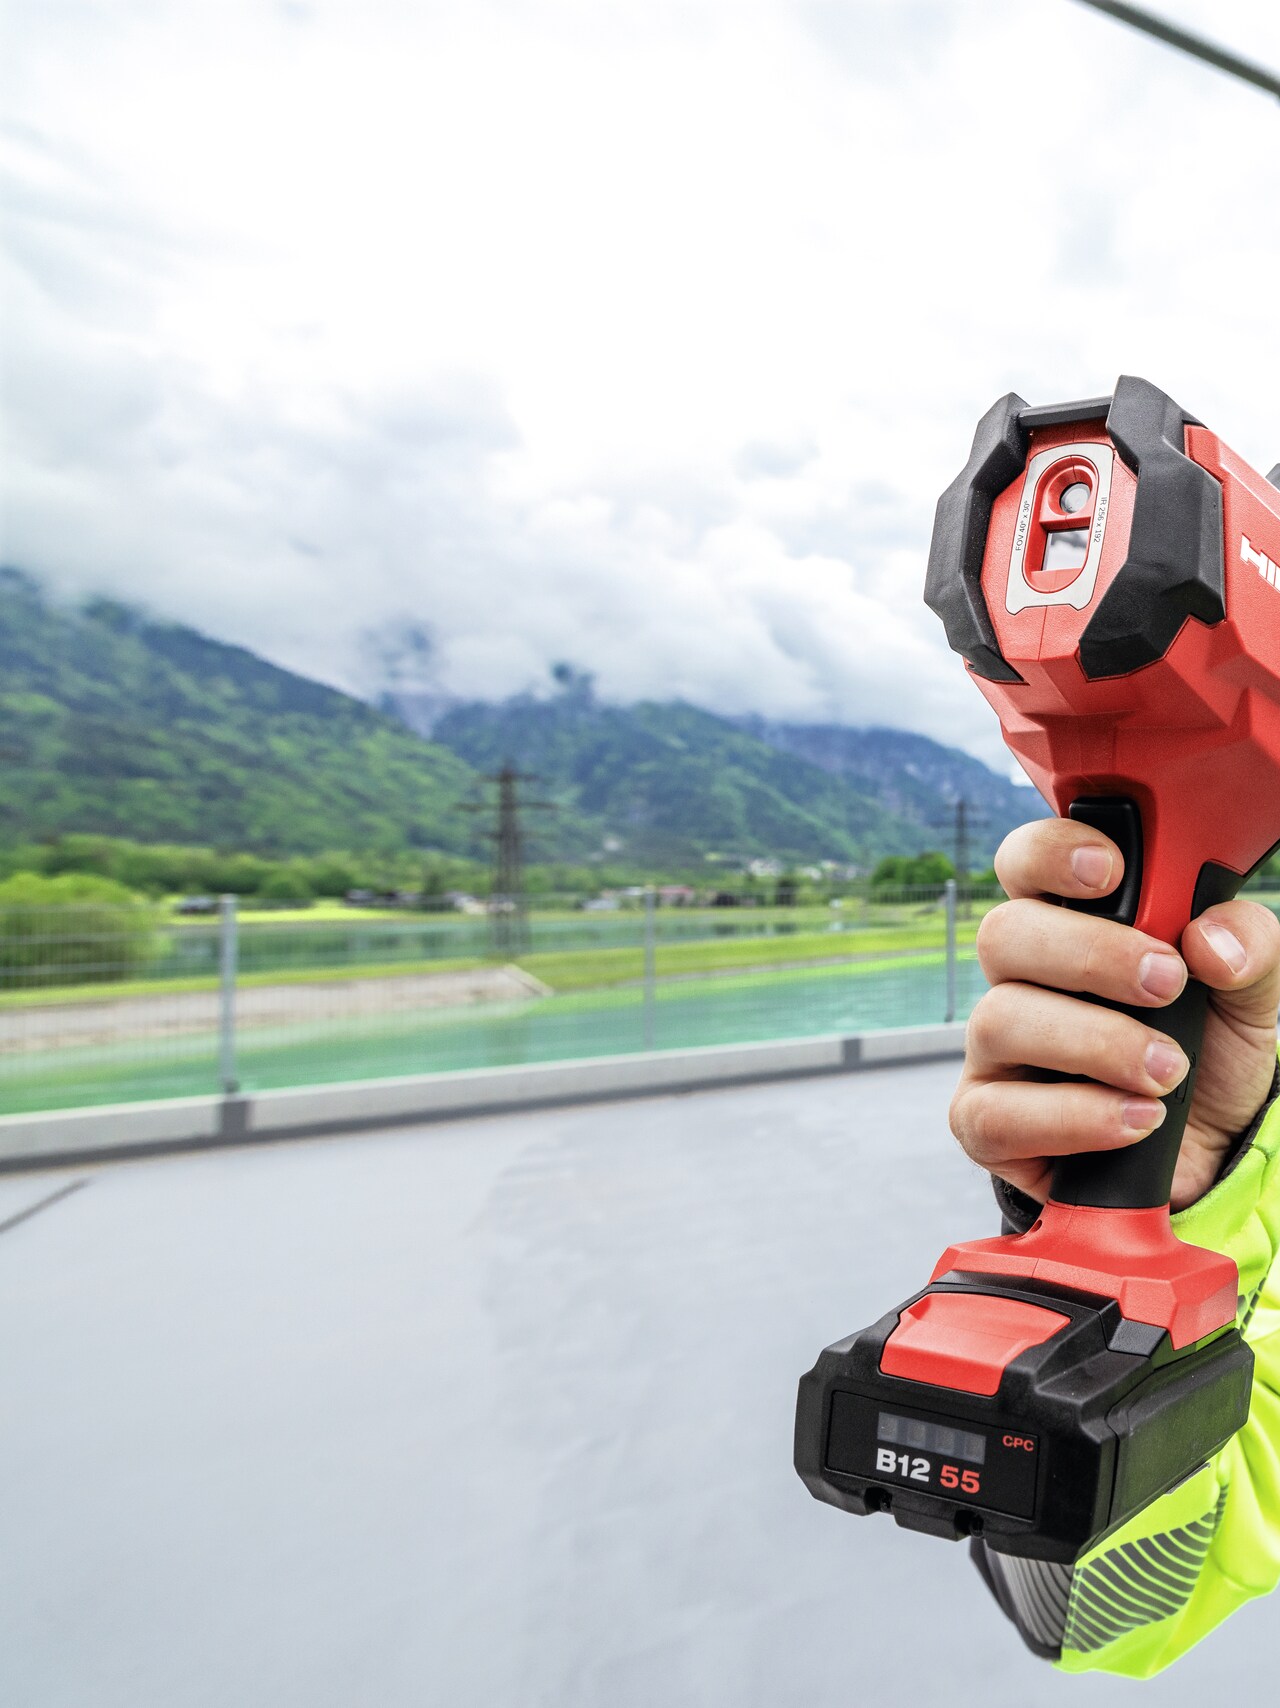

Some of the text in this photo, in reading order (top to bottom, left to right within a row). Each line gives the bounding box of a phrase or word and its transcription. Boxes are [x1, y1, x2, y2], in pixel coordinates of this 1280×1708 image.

[1100, 496, 1108, 506] IR
[1098, 507, 1106, 521] 256
[1015, 534, 1024, 551] FOV
[1094, 530, 1102, 543] 192
[1002, 1435, 1035, 1452] CPC
[876, 1448, 981, 1494] B12 55
